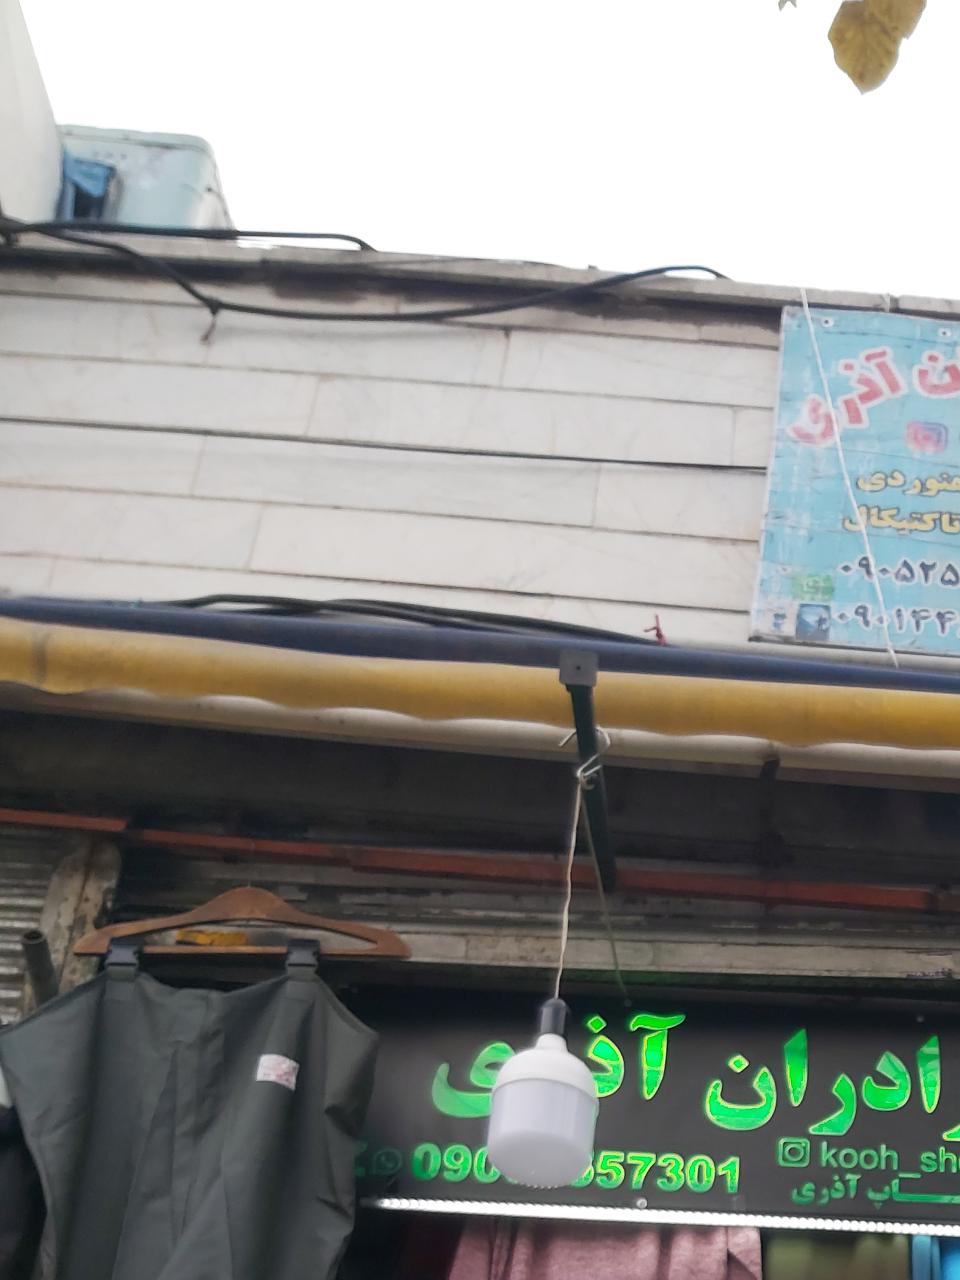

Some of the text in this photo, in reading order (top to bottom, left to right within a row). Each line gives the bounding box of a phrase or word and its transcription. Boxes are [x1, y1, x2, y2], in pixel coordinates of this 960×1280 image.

[789, 350, 902, 444] آذری
[430, 1013, 687, 1119] آذی
[410, 1142, 741, 1194] 09057301
[790, 1173, 862, 1206] آذری
